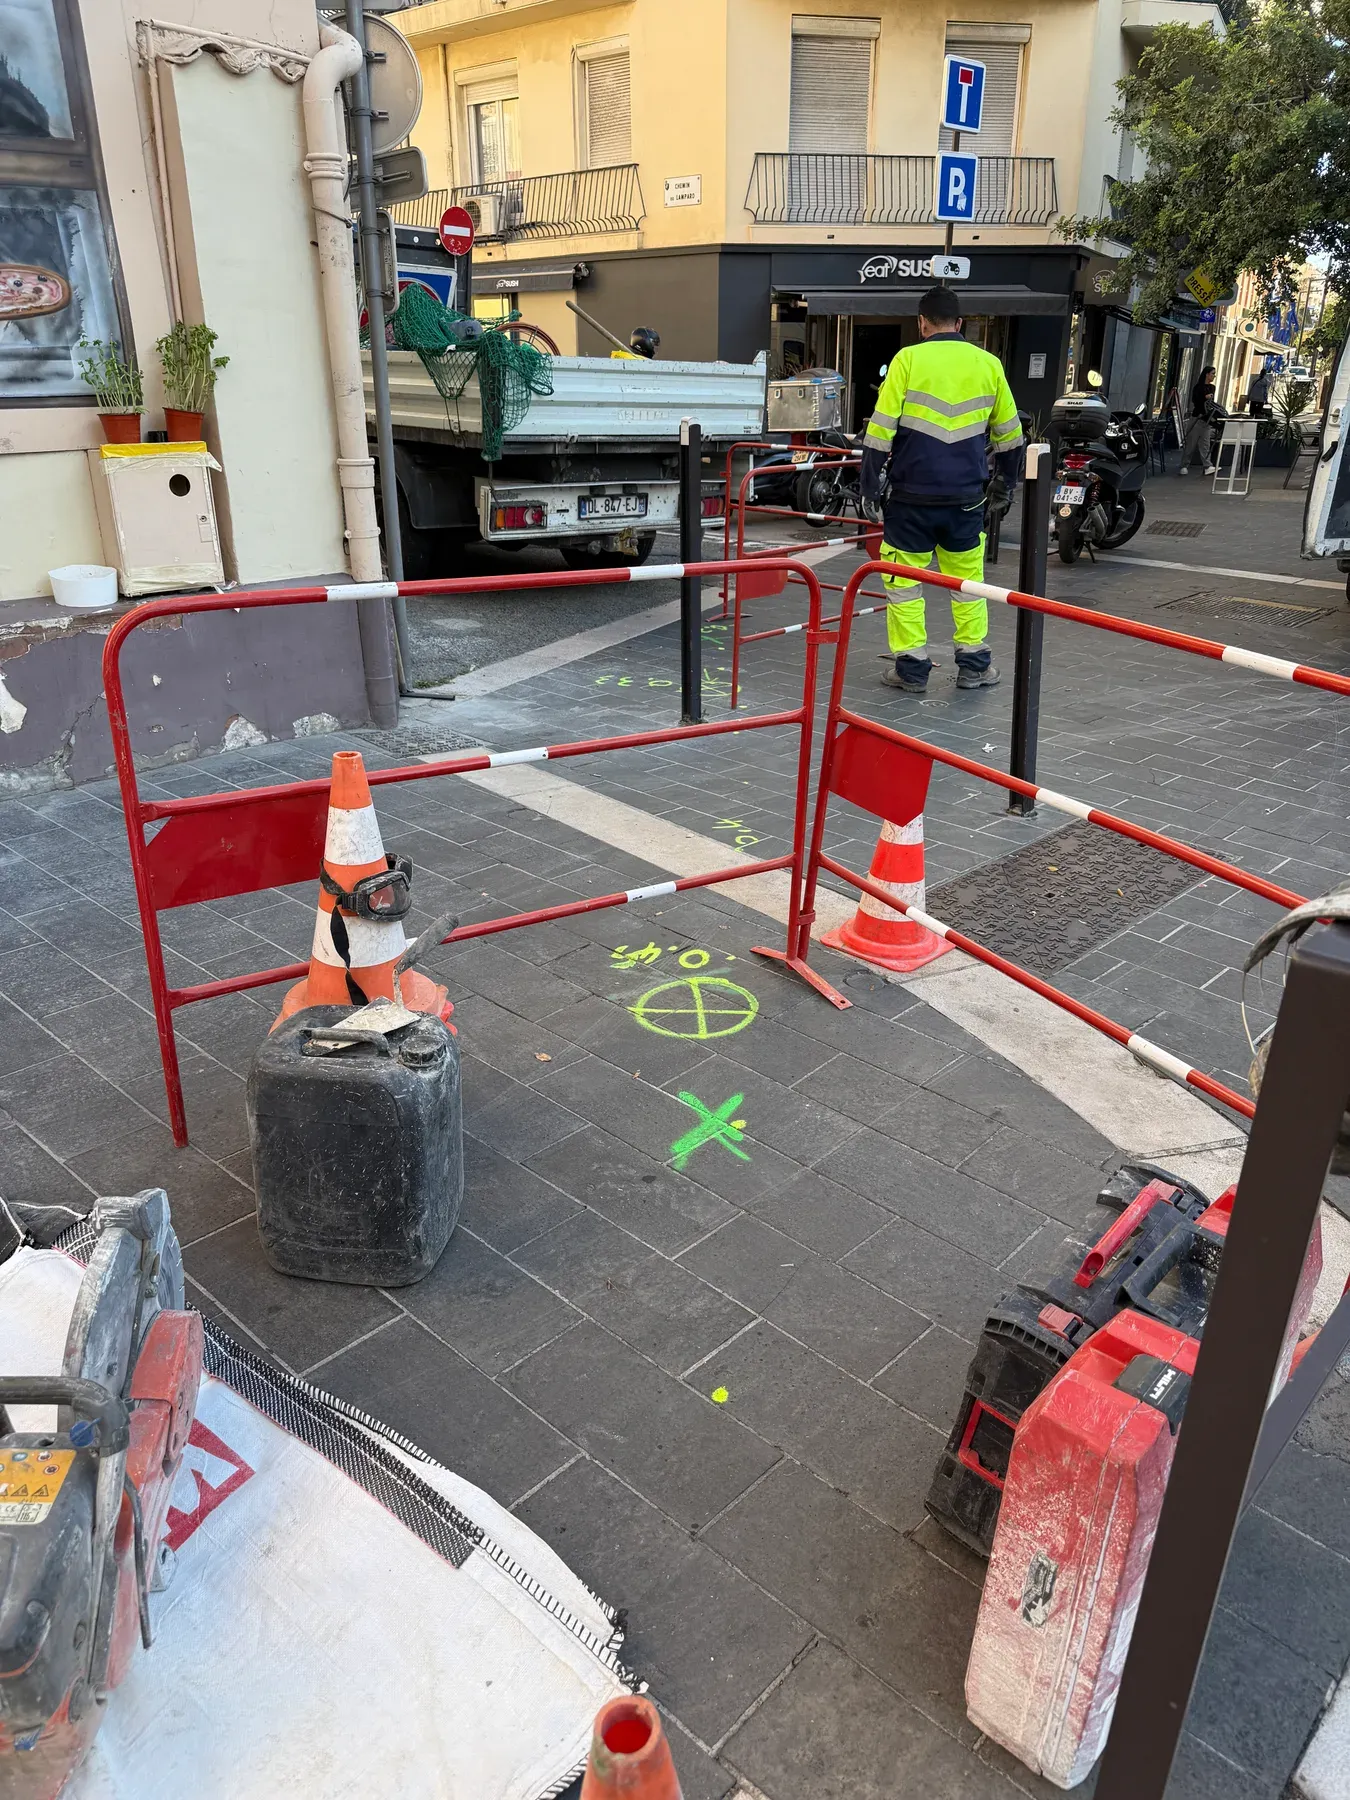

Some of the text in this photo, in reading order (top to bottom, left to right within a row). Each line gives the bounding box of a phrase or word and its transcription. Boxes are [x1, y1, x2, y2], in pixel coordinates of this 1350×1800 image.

[674, 182, 691, 190] CHEMIN
[864, 263, 891, 278] eat
[1187, 275, 1211, 304] PRESSE
[588, 497, 638, 514] DL-847-EJ
[1149, 1368, 1177, 1400] HILTI
